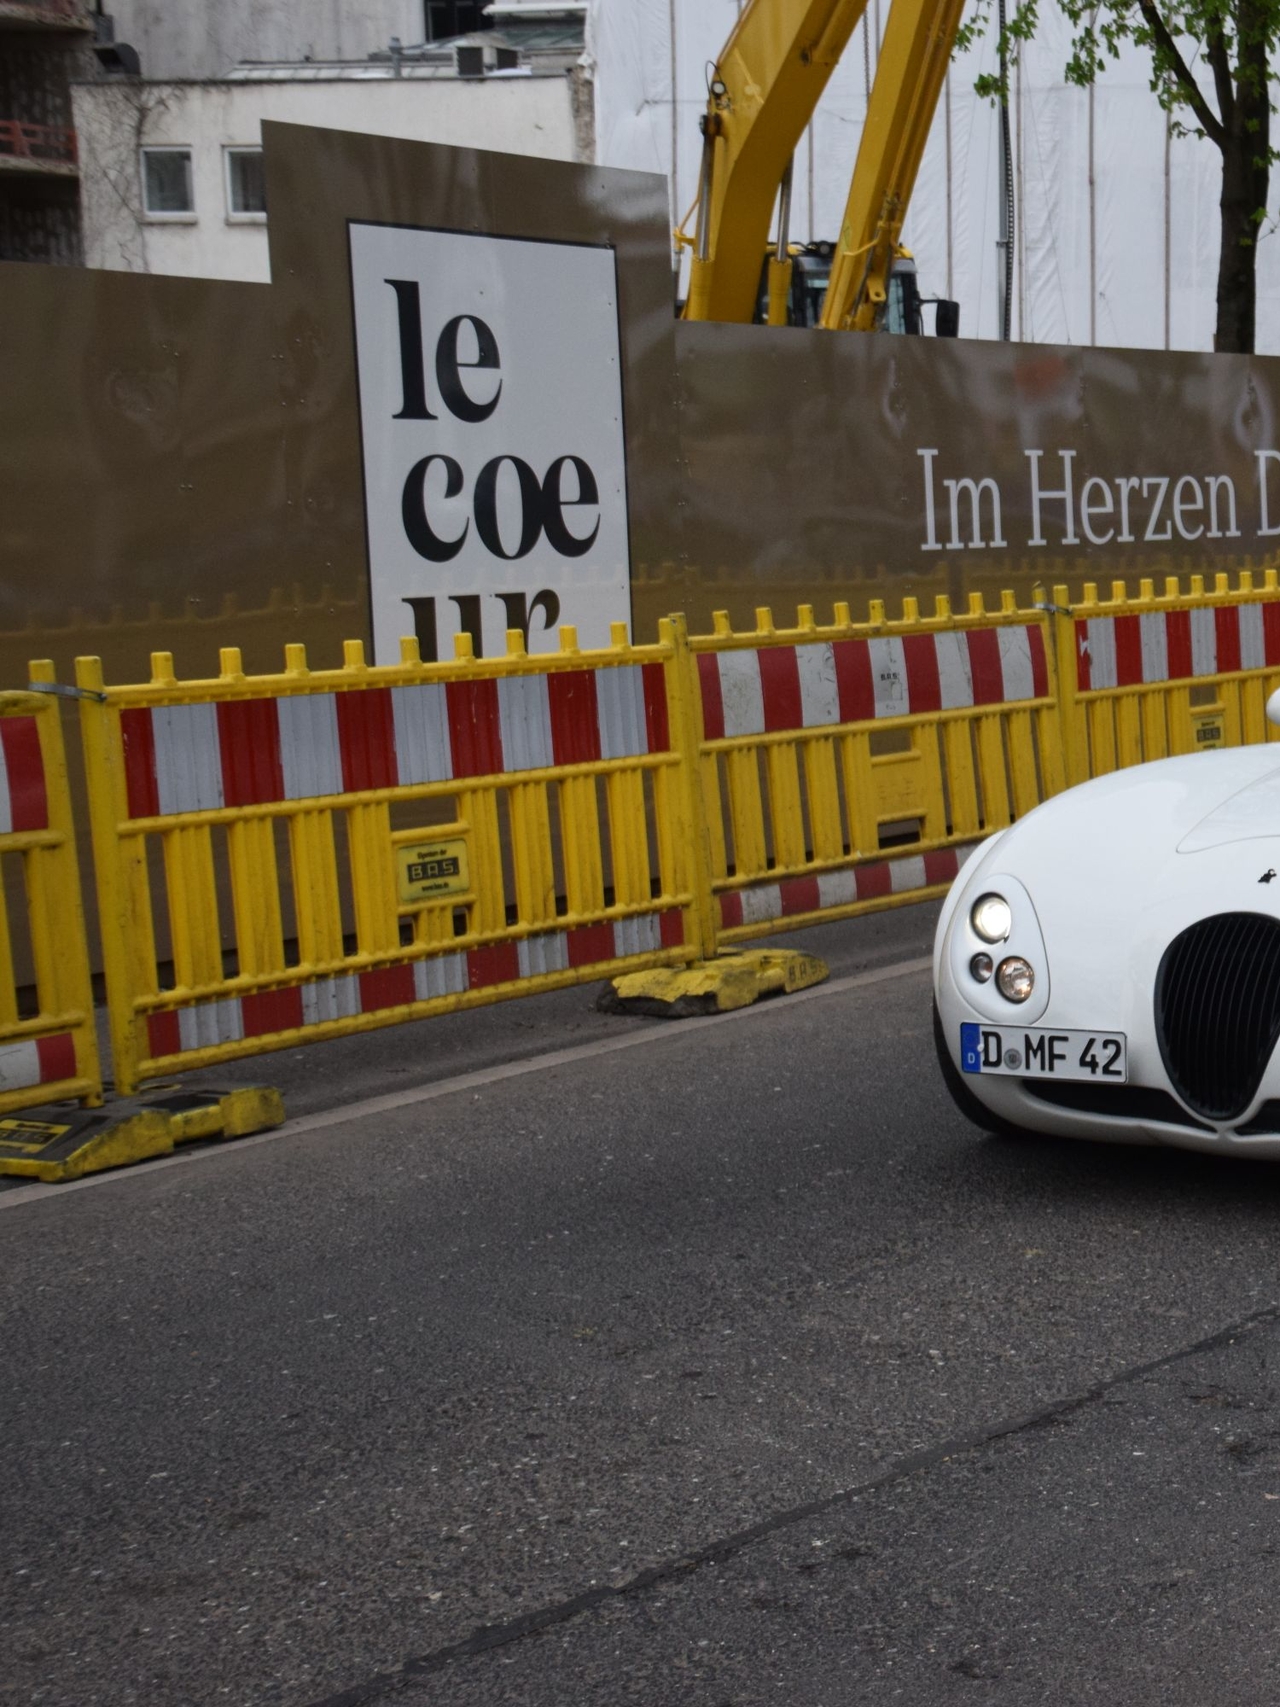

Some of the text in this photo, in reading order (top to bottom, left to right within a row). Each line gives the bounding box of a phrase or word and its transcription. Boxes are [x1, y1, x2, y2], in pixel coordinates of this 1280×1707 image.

[384, 279, 502, 423] le
[402, 454, 601, 563] coe
[917, 449, 1007, 550] Im
[1024, 450, 1241, 546] Herzen
[967, 1052, 975, 1064] D
[982, 1030, 1123, 1076] D MF 42
